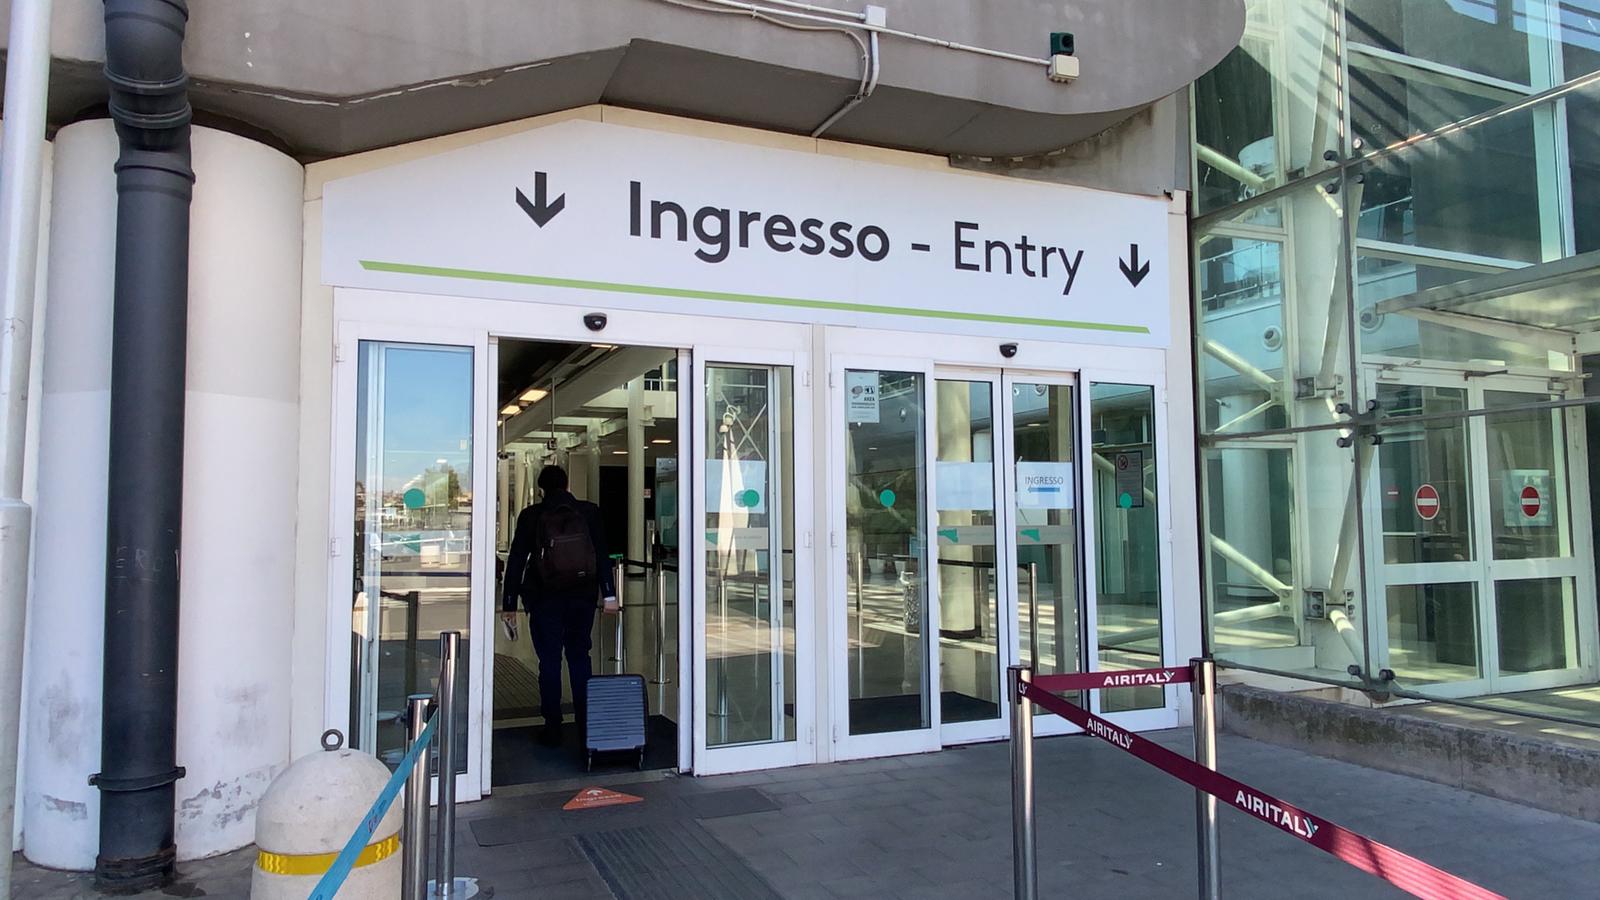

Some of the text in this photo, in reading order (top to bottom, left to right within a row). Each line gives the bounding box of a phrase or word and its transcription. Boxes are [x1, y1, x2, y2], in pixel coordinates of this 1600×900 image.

[630, 180, 1085, 296] Ingresso - Entry
[1024, 475, 1064, 485] INGRESSO
[1103, 670, 1175, 686] AIRITALY
[1086, 718, 1133, 749] AIRITALY
[1235, 789, 1319, 839] AIRITALY
